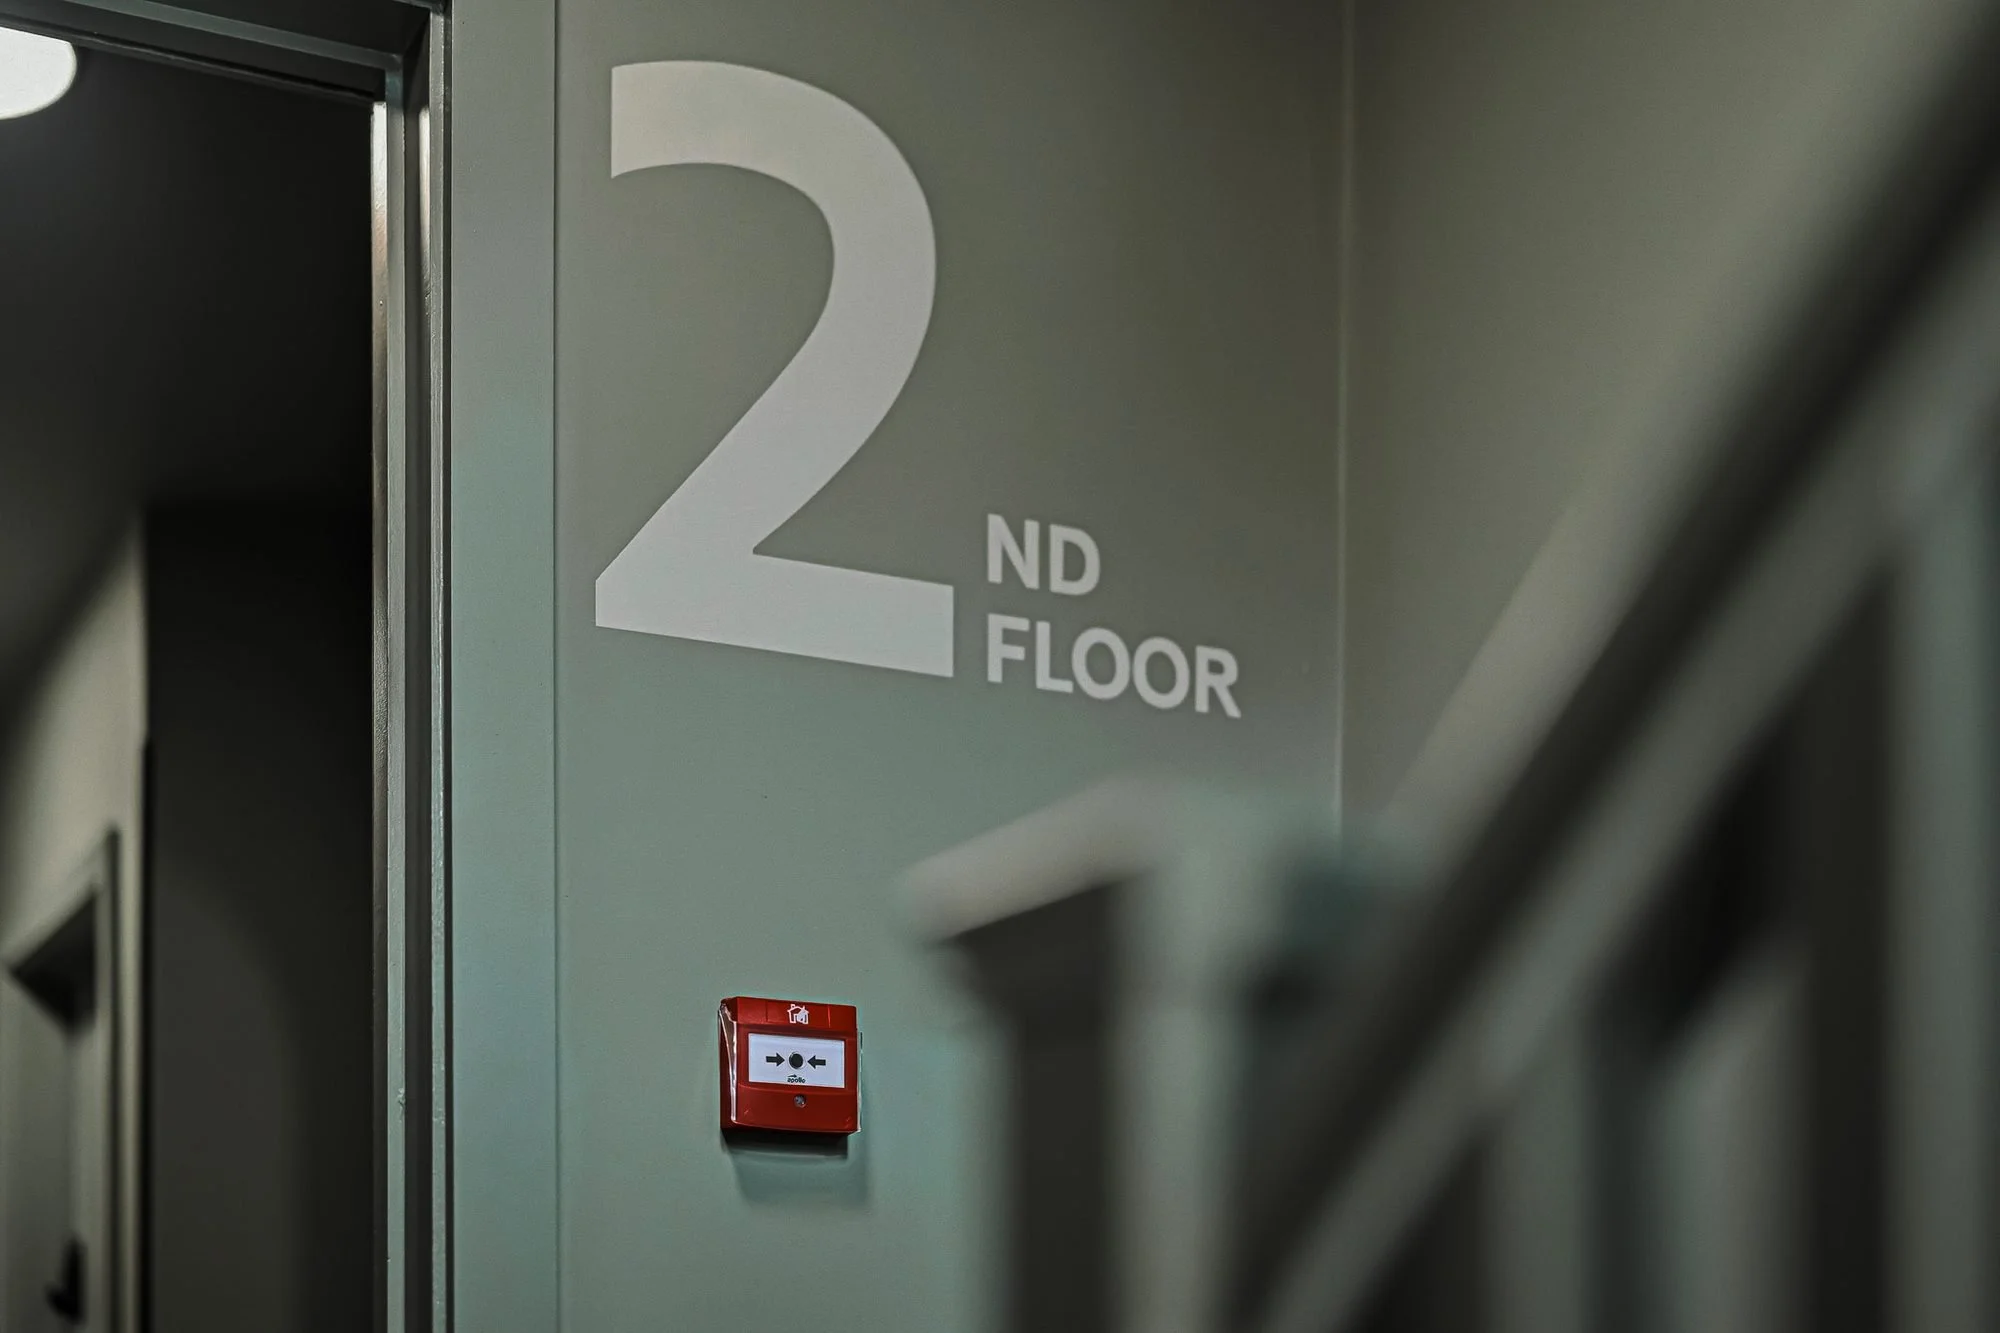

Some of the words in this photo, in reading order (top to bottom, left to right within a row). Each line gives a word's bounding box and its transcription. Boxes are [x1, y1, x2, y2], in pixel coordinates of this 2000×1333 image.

[595, 60, 954, 677] 2
[987, 513, 1101, 596] ND
[987, 613, 1242, 719] FLOOR
